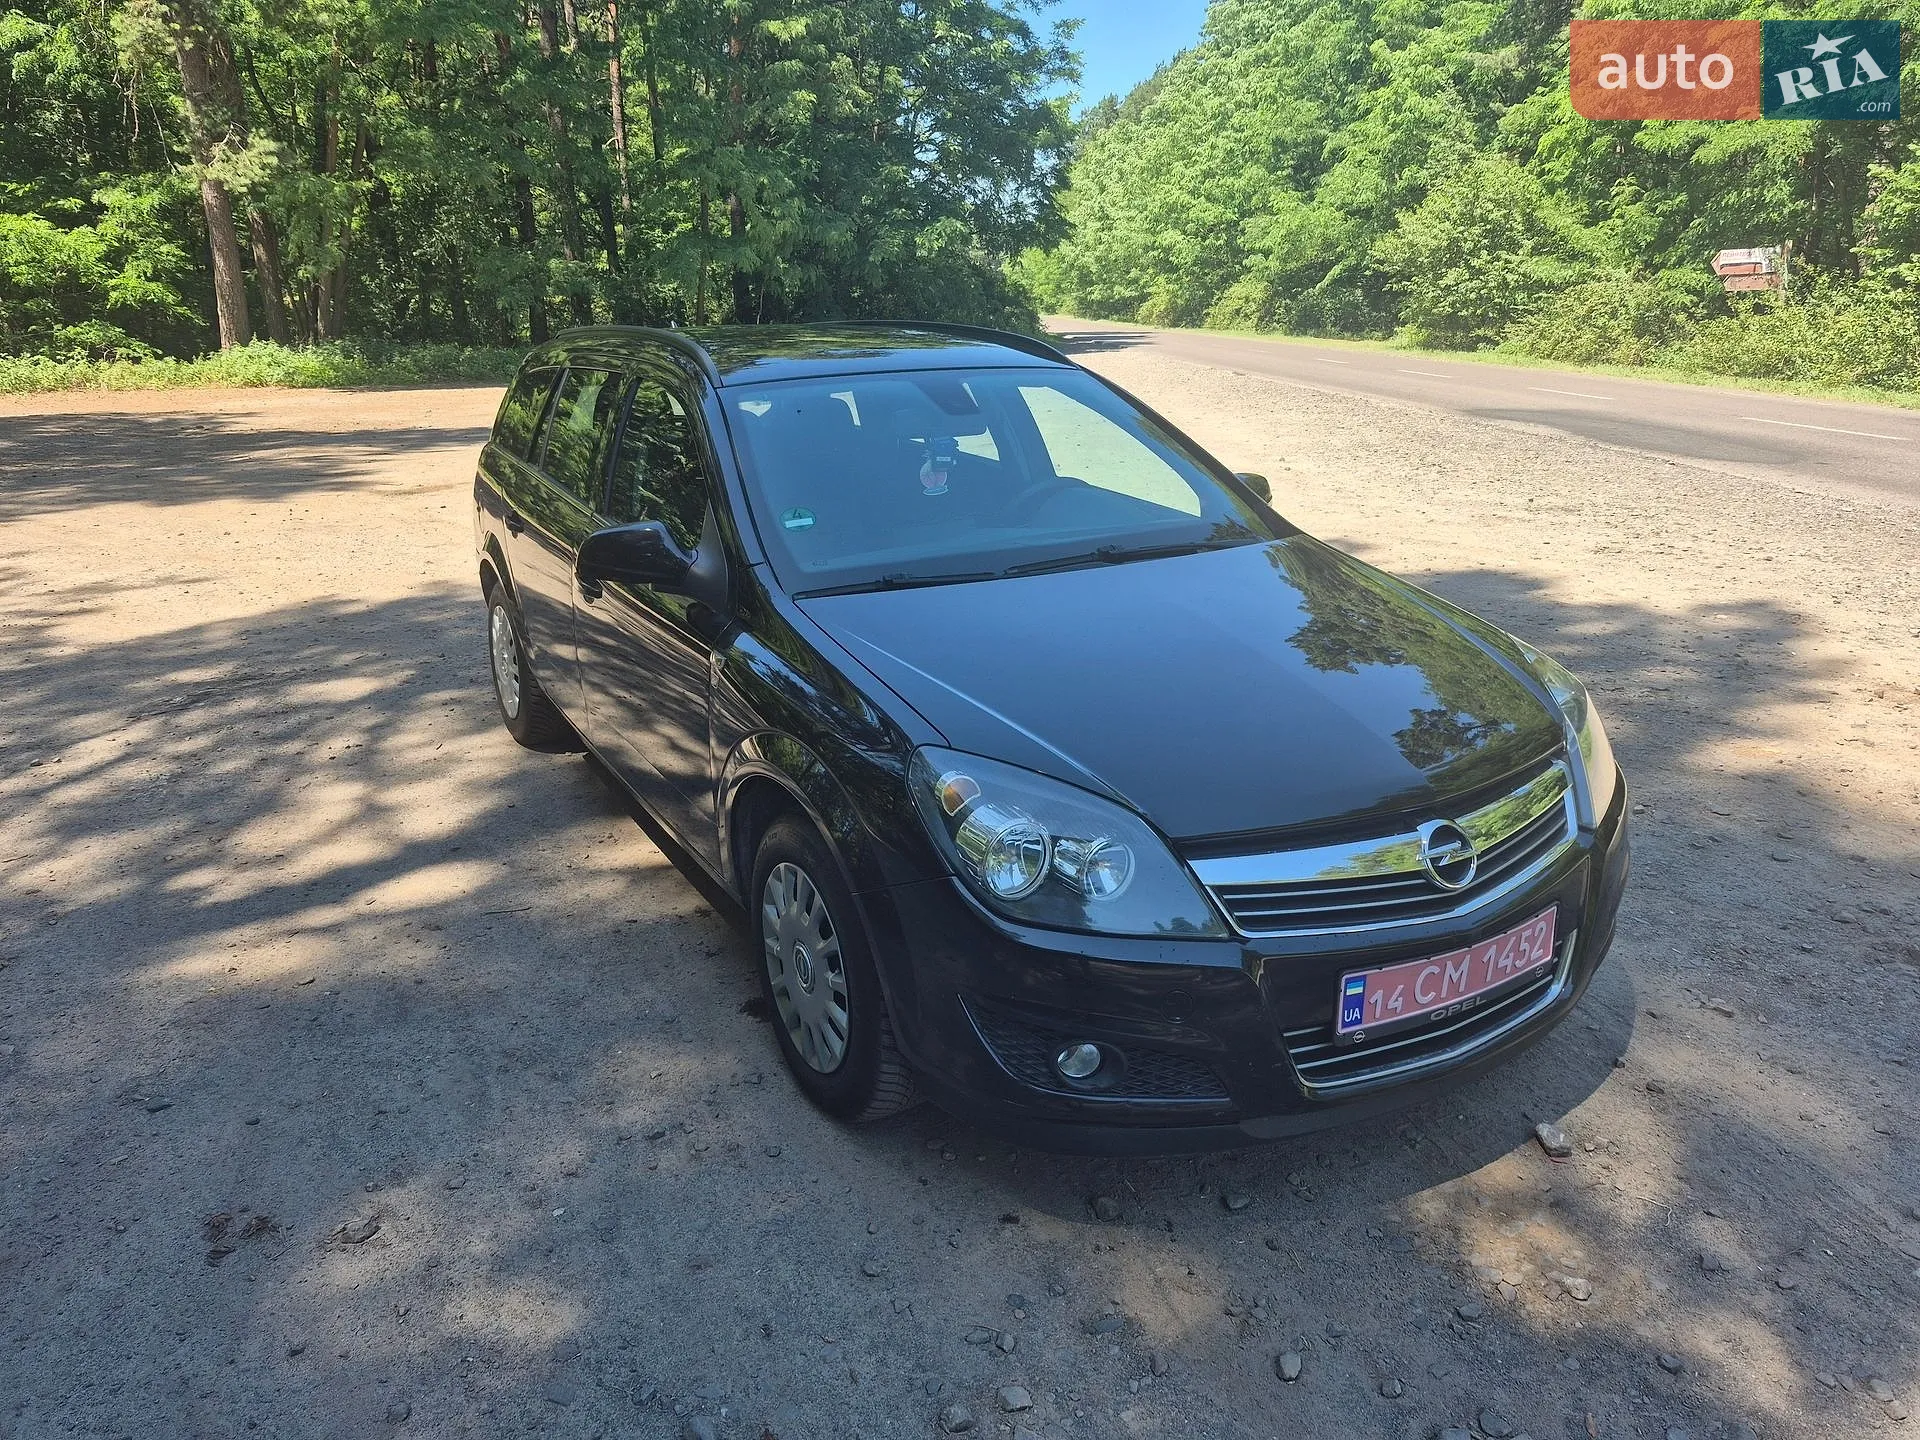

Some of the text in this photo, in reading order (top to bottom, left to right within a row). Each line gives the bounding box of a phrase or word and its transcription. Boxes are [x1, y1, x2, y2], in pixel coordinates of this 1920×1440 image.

[1368, 921, 1547, 1019] 14 CM 1452
[1344, 1008, 1361, 1023] UA
[1430, 996, 1487, 1021] OPEL
